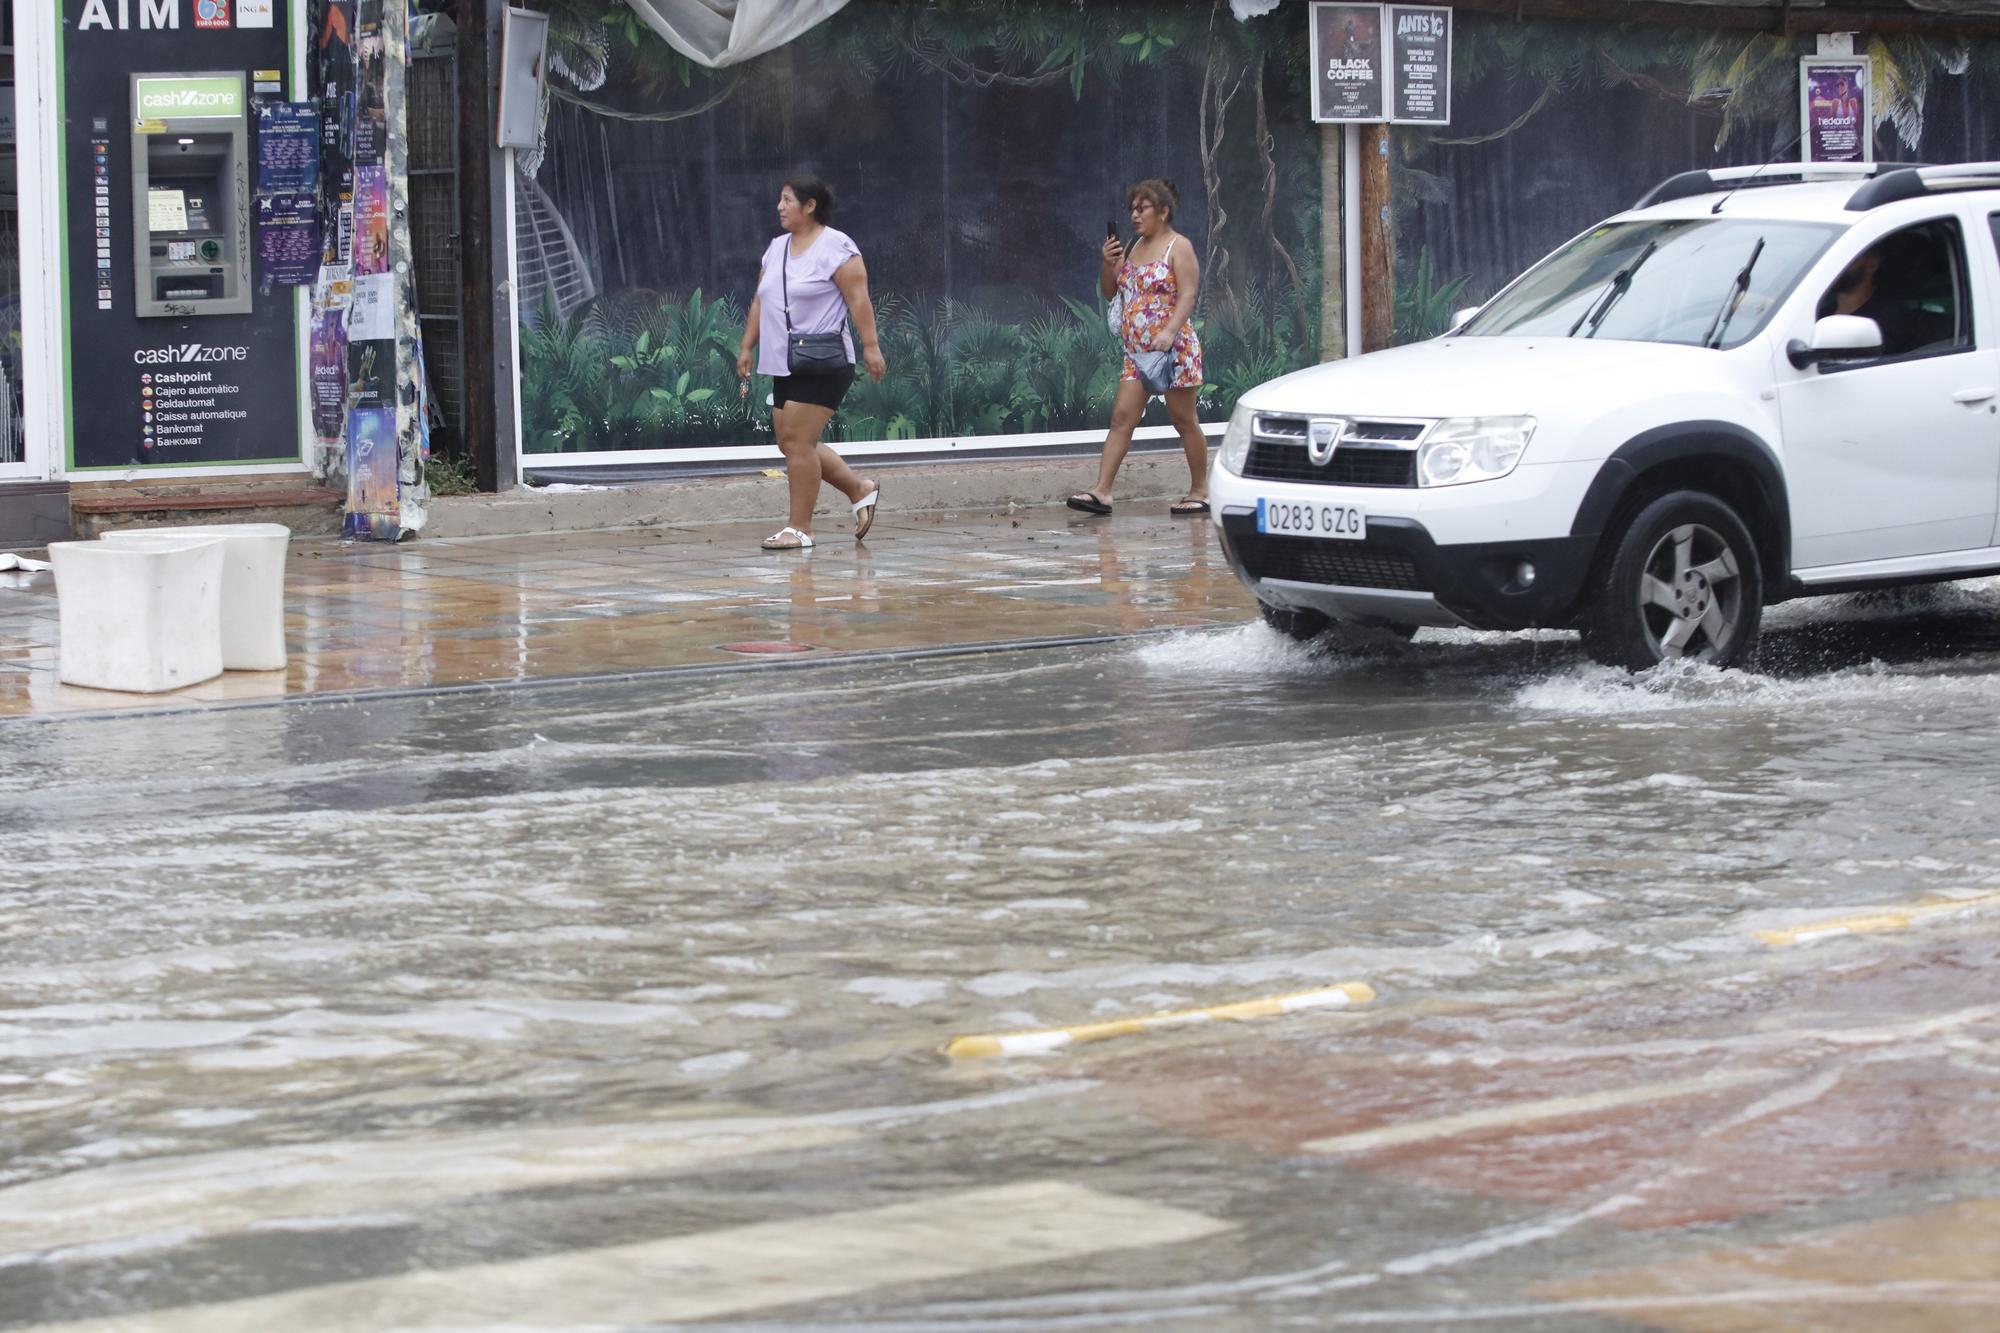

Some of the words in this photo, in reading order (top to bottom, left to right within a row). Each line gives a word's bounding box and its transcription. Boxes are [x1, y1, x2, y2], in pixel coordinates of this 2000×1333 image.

[239, 5, 257, 14] ING
[196, 19, 212, 27] EURO
[1397, 14, 1430, 35] ANTS
[1329, 58, 1370, 69] BLACK
[1327, 70, 1373, 80] COFFEE
[143, 89, 181, 107] cash
[198, 91, 235, 106] zone
[134, 344, 179, 365] cash
[154, 371, 212, 385] Cashpoint
[155, 386, 187, 399] Cajero
[188, 384, 240, 396] automático
[155, 397, 216, 410] Geldautomat
[156, 411, 189, 423] Caisse
[190, 409, 248, 422] automatique
[156, 423, 204, 435] Bankomat
[156, 436, 203, 447] Банкомат
[1269, 504, 1314, 531] 0283
[1321, 507, 1359, 534] GZG
